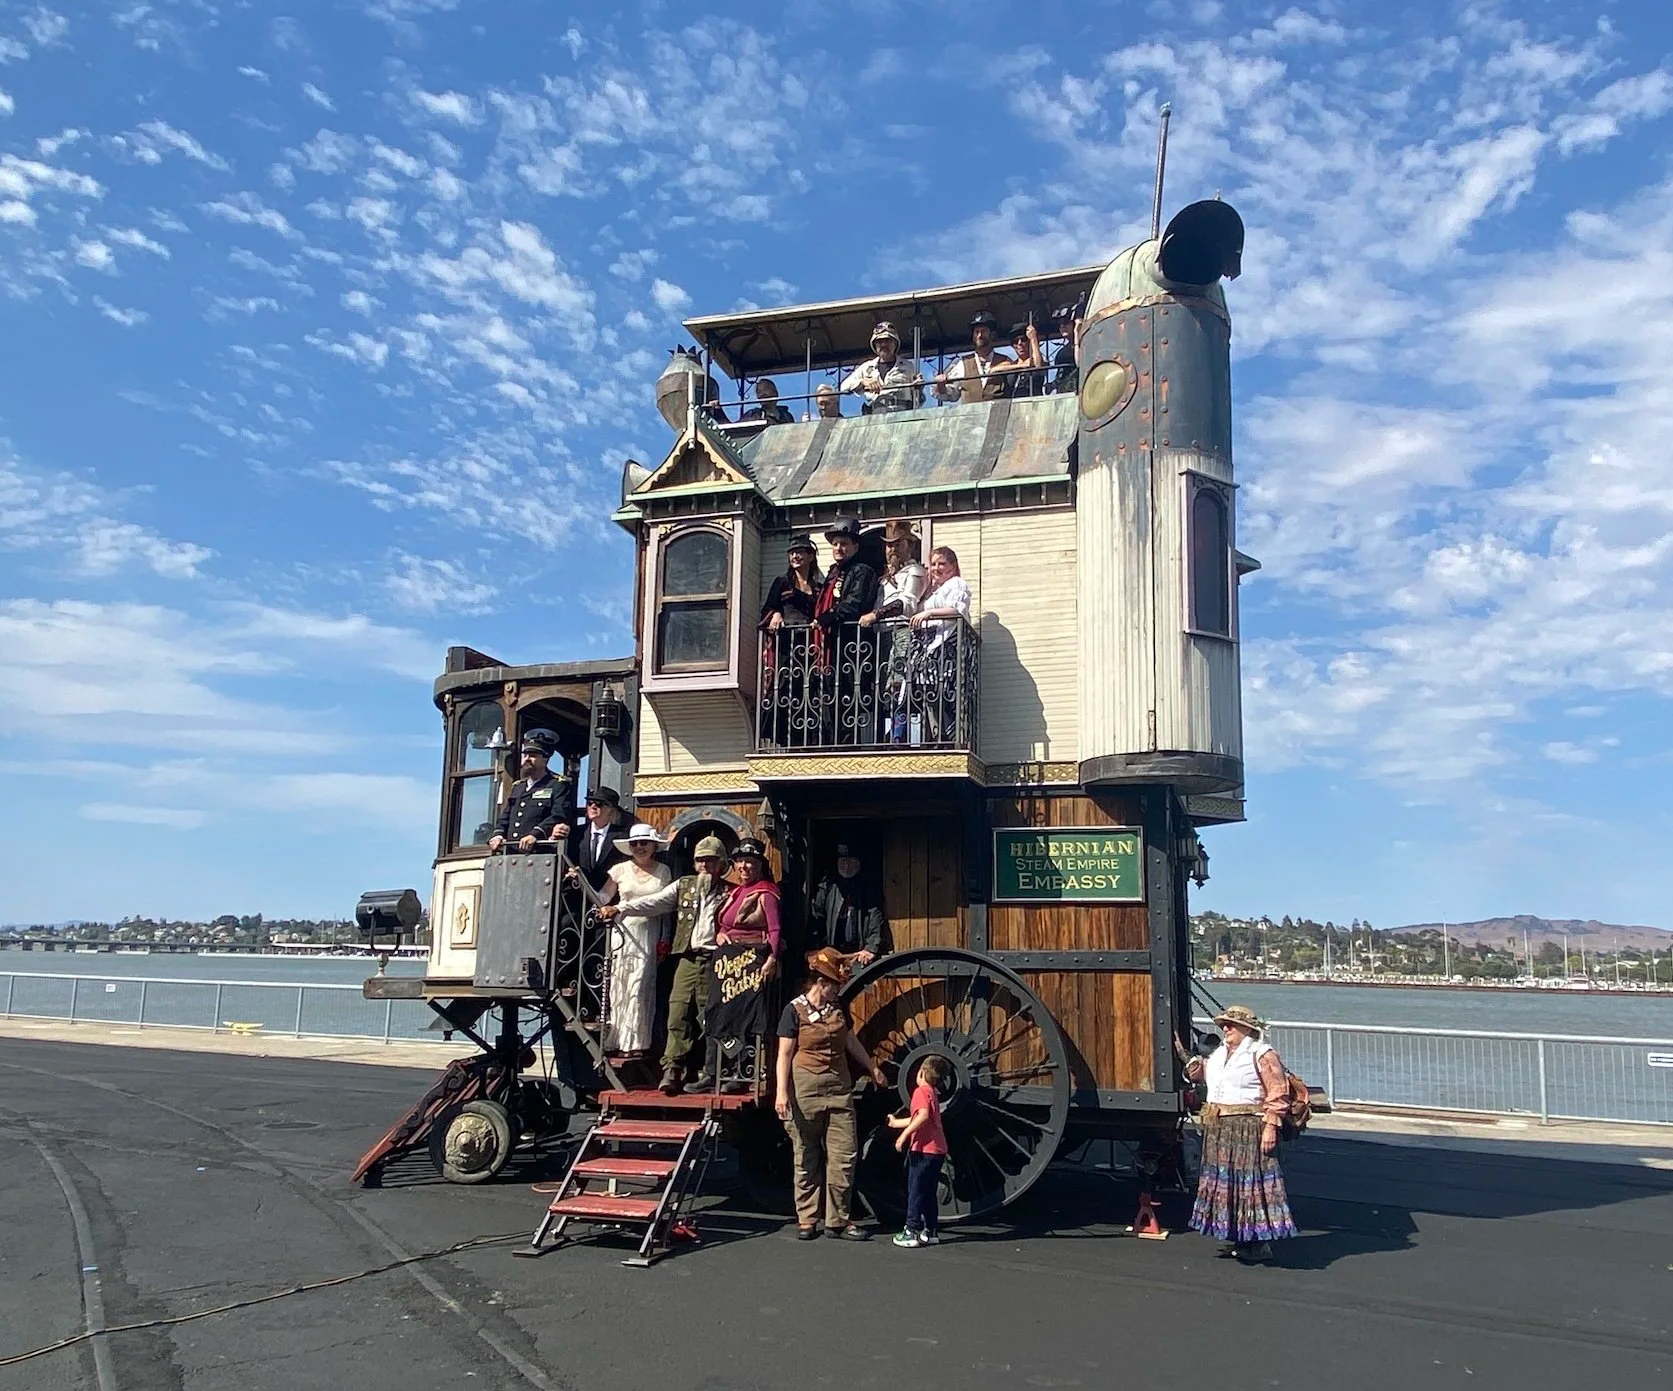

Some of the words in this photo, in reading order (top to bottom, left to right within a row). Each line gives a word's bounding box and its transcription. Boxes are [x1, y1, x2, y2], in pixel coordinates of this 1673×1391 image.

[1010, 840, 1134, 857] HIBERNIAN
[1016, 857, 1063, 871] STEAM
[1067, 857, 1120, 870] EMPIRE
[1018, 872, 1121, 890] EMBASSY
[714, 947, 757, 980] Vegas
[721, 968, 763, 1004] Baby
